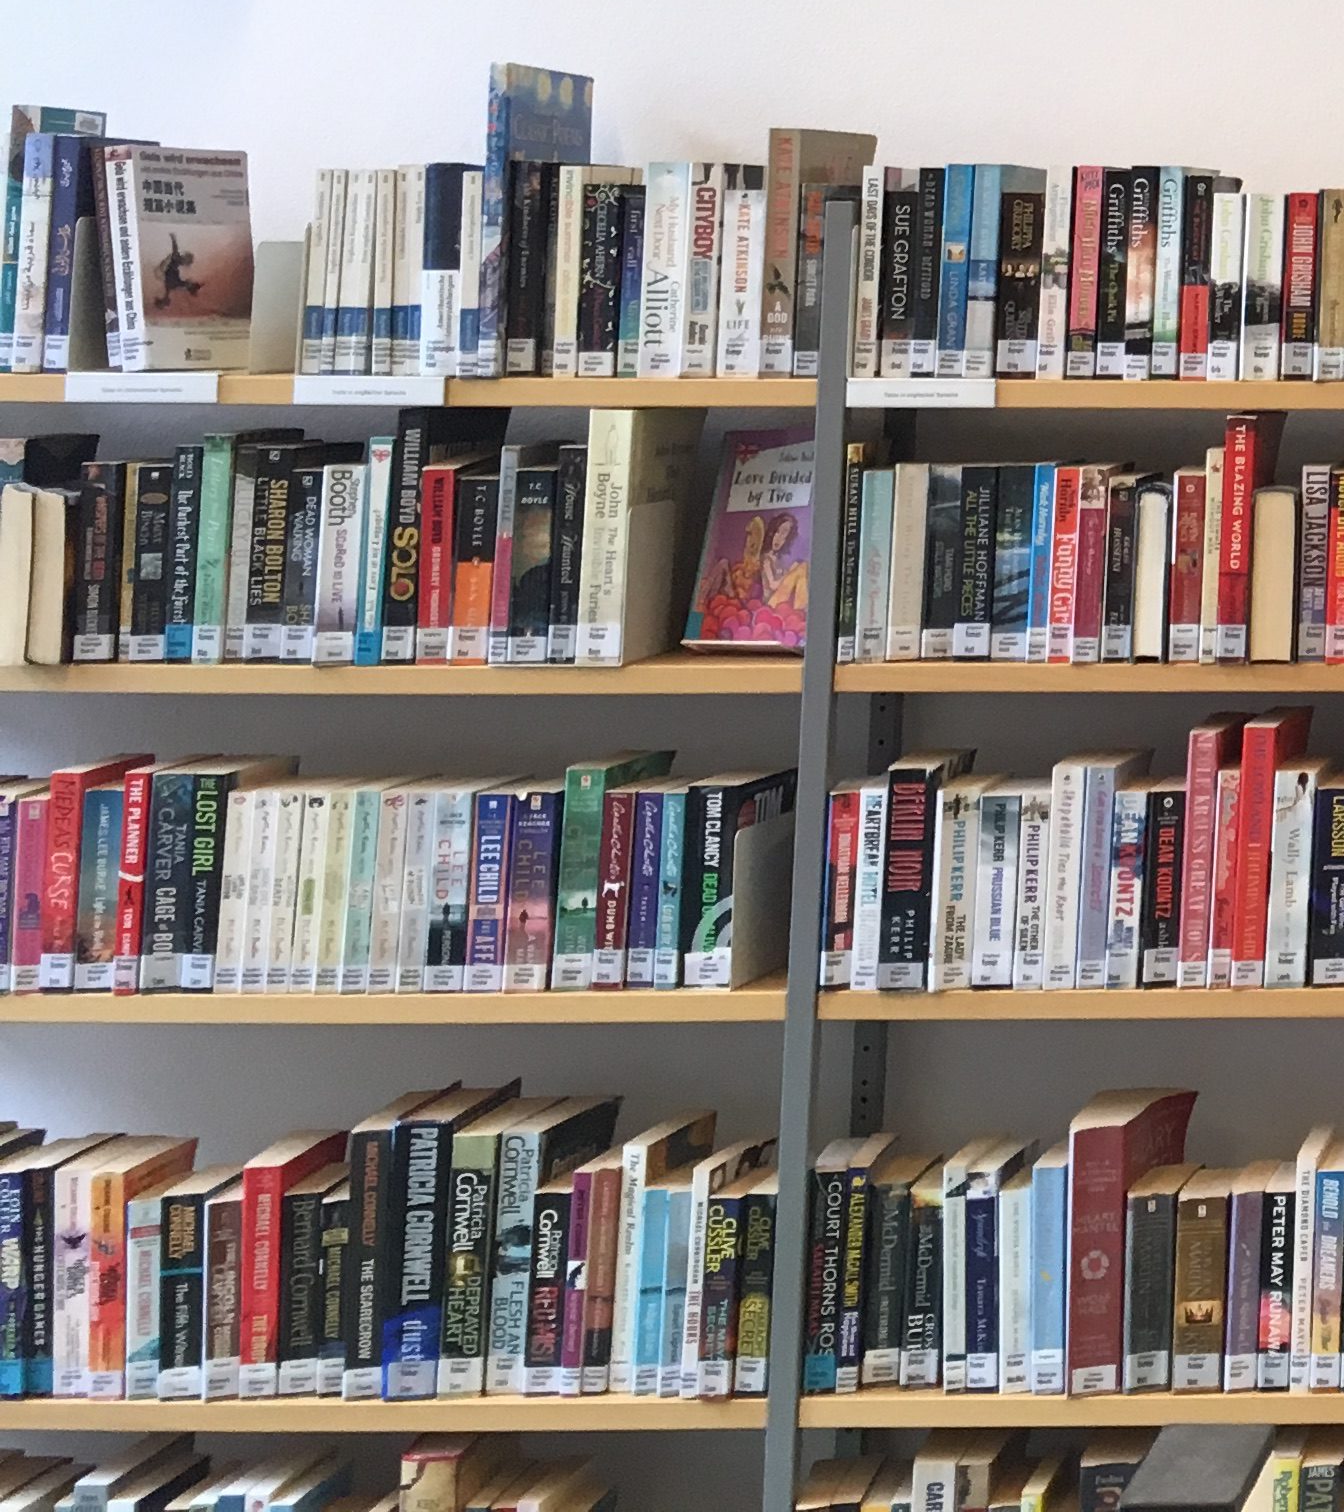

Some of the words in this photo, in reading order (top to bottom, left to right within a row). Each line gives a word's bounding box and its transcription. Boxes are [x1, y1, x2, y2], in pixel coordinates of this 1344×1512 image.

[114, 161, 126, 175] Gela
[116, 176, 127, 190] wird
[867, 178, 879, 198] LAST
[116, 191, 129, 225] erwachsen
[595, 203, 607, 243] CECELIA
[693, 187, 717, 260] CITYBOY
[737, 203, 751, 232] KATE
[865, 221, 877, 232] OF
[866, 200, 878, 220] DAYS
[894, 205, 910, 236] SUE
[1106, 183, 1124, 253] Griffiths
[119, 226, 130, 238] und
[120, 239, 132, 261] andere
[865, 233, 876, 247] THE
[1293, 223, 1314, 253] JOHN
[120, 261, 135, 299] Erzählungen
[594, 245, 606, 278] AHERN
[734, 236, 750, 293] ATKINSON
[863, 249, 876, 282] CONDOR
[891, 240, 908, 320] GRAFTON
[1109, 263, 1120, 280] The
[1290, 256, 1313, 307] GRISHAM
[644, 268, 668, 348] Alliott
[1106, 310, 1117, 322] Pit
[1107, 282, 1119, 308] Chalk
[126, 313, 137, 330] China
[401, 429, 421, 486] WILLIAM
[1234, 425, 1246, 453] THE
[254, 477, 269, 523] LITTLE
[329, 469, 352, 527] Booth
[399, 489, 418, 524] BOYD
[1232, 456, 1245, 516] BLAZING
[1306, 471, 1327, 506] LISA
[266, 479, 287, 540] SHARON
[251, 527, 266, 571] BLACK
[390, 526, 418, 601] SOLO
[1052, 533, 1075, 590] Funny
[1229, 520, 1243, 570] WORLD
[1303, 512, 1325, 588] JACKSON
[249, 576, 263, 606] LIES
[262, 545, 284, 603] BOLTON
[129, 779, 144, 804] THE
[195, 790, 218, 834] LOST
[706, 792, 723, 818] TOM
[890, 782, 926, 841] BERLIN
[125, 807, 141, 864] PLANNER
[191, 837, 215, 876] GIRL
[480, 834, 502, 861] LEE
[703, 820, 721, 868] CLANCY
[1026, 824, 1041, 867] PHILIP
[1284, 828, 1300, 865] Wally
[48, 852, 74, 909] CURSE
[477, 863, 500, 903] CHILD
[887, 849, 924, 893] NOIR
[1025, 869, 1039, 904] KERR
[1285, 870, 1299, 908] Lamb
[889, 915, 901, 954] KERR
[904, 909, 915, 960] PHILIP
[407, 1127, 438, 1207] PATRICIA
[453, 1172, 478, 1253] Cornwell
[470, 1184, 487, 1239] Patricia
[825, 1181, 843, 1239] COURT
[1271, 1195, 1286, 1248] PETER
[400, 1210, 433, 1305] CORNWELL
[706, 1205, 725, 1273] CUSSLER
[722, 1216, 738, 1259] CLIVE
[361, 1259, 375, 1281] THE
[821, 1246, 838, 1316] THORNS
[1270, 1252, 1283, 1287] MAY
[359, 1283, 374, 1359] SCARECROW
[447, 1288, 463, 1346] HEART
[462, 1276, 480, 1354] DEPRAVED
